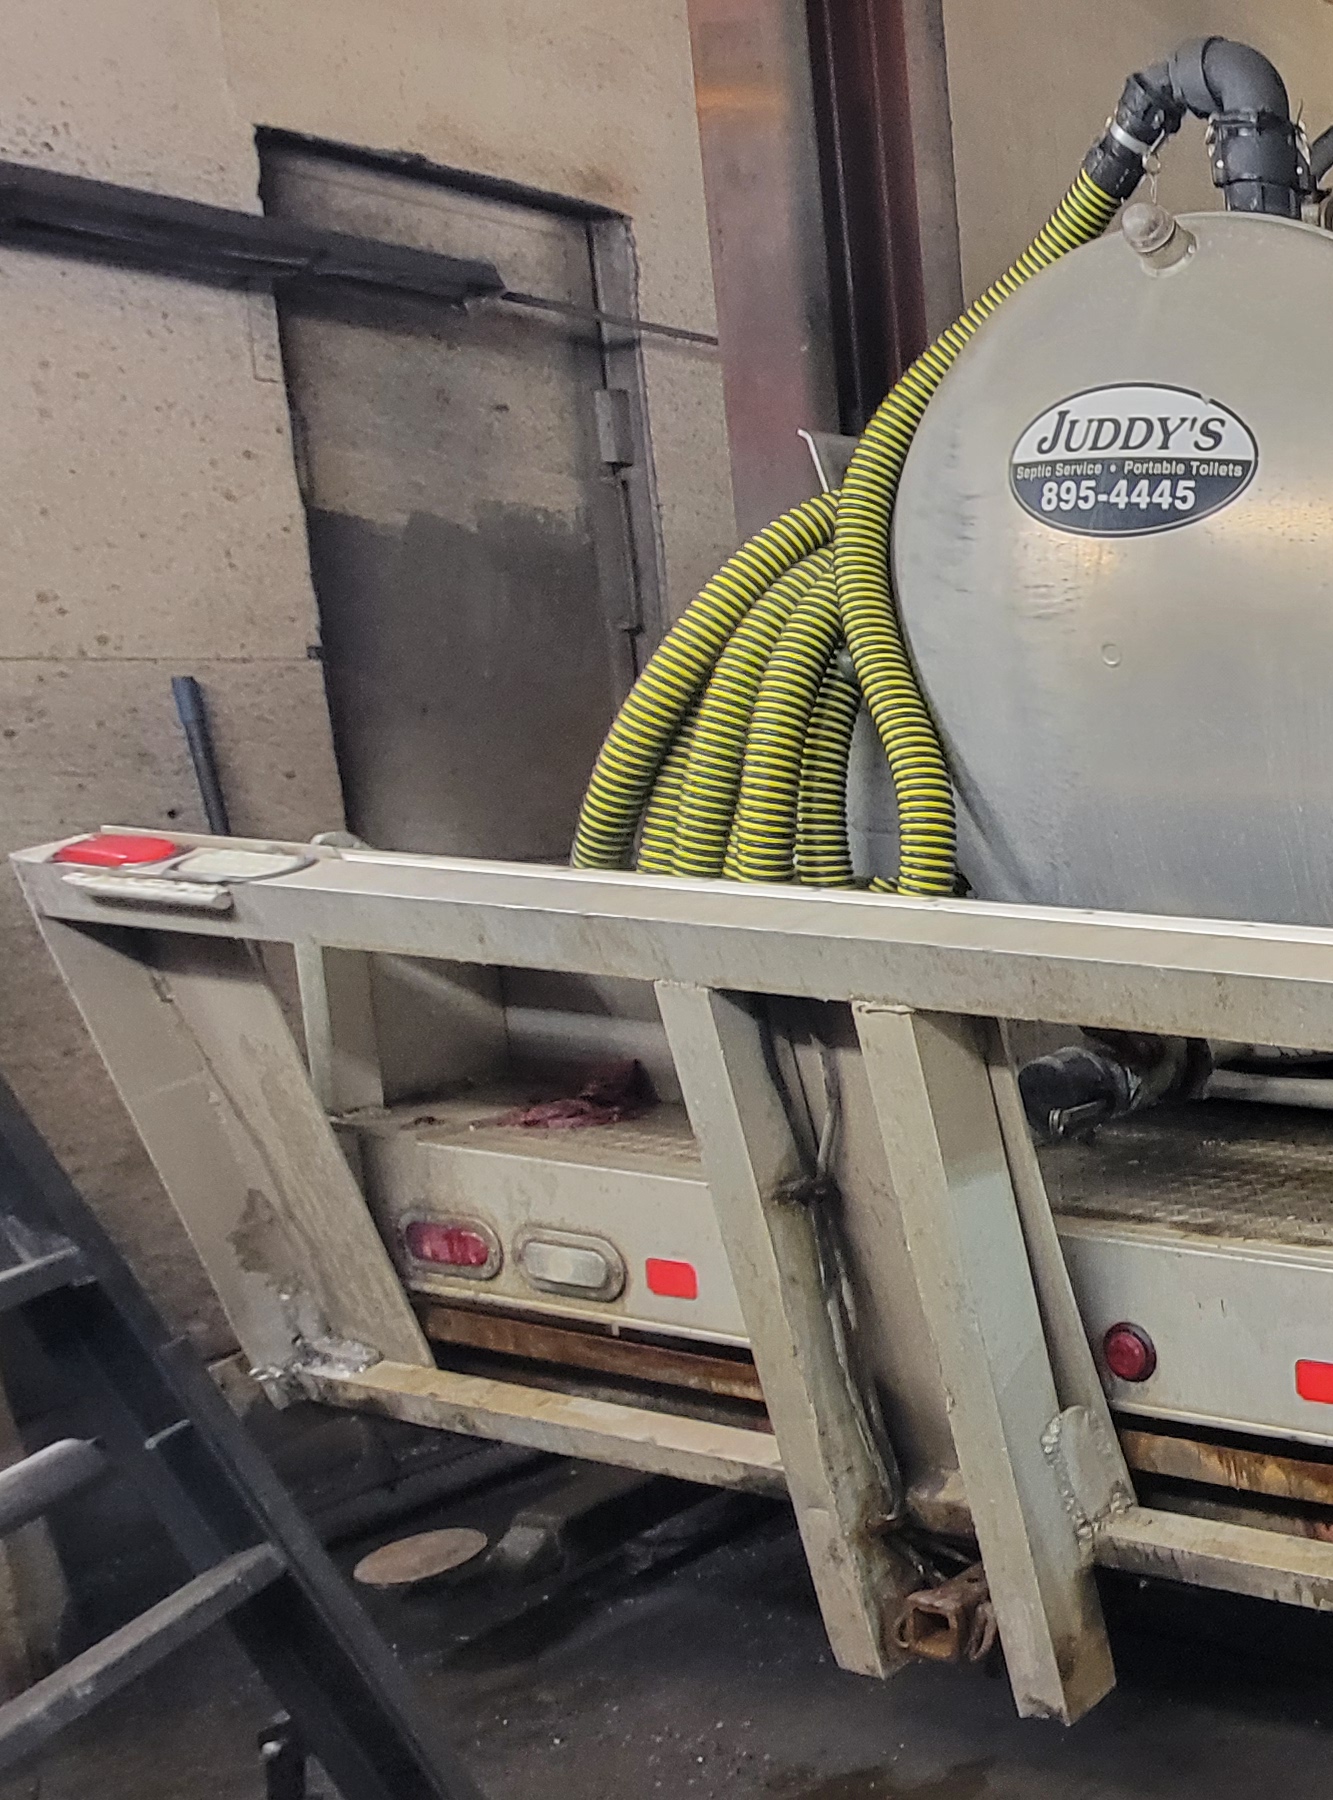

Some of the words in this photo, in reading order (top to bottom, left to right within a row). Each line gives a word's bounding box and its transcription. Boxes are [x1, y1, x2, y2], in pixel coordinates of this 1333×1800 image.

[1036, 409, 1227, 455] JUDDY'S
[1015, 462, 1052, 481] Septic
[1055, 461, 1103, 478] Service
[1123, 460, 1186, 476] Portable
[1190, 461, 1243, 477] Toilets
[1040, 478, 1196, 511] 895-4445
